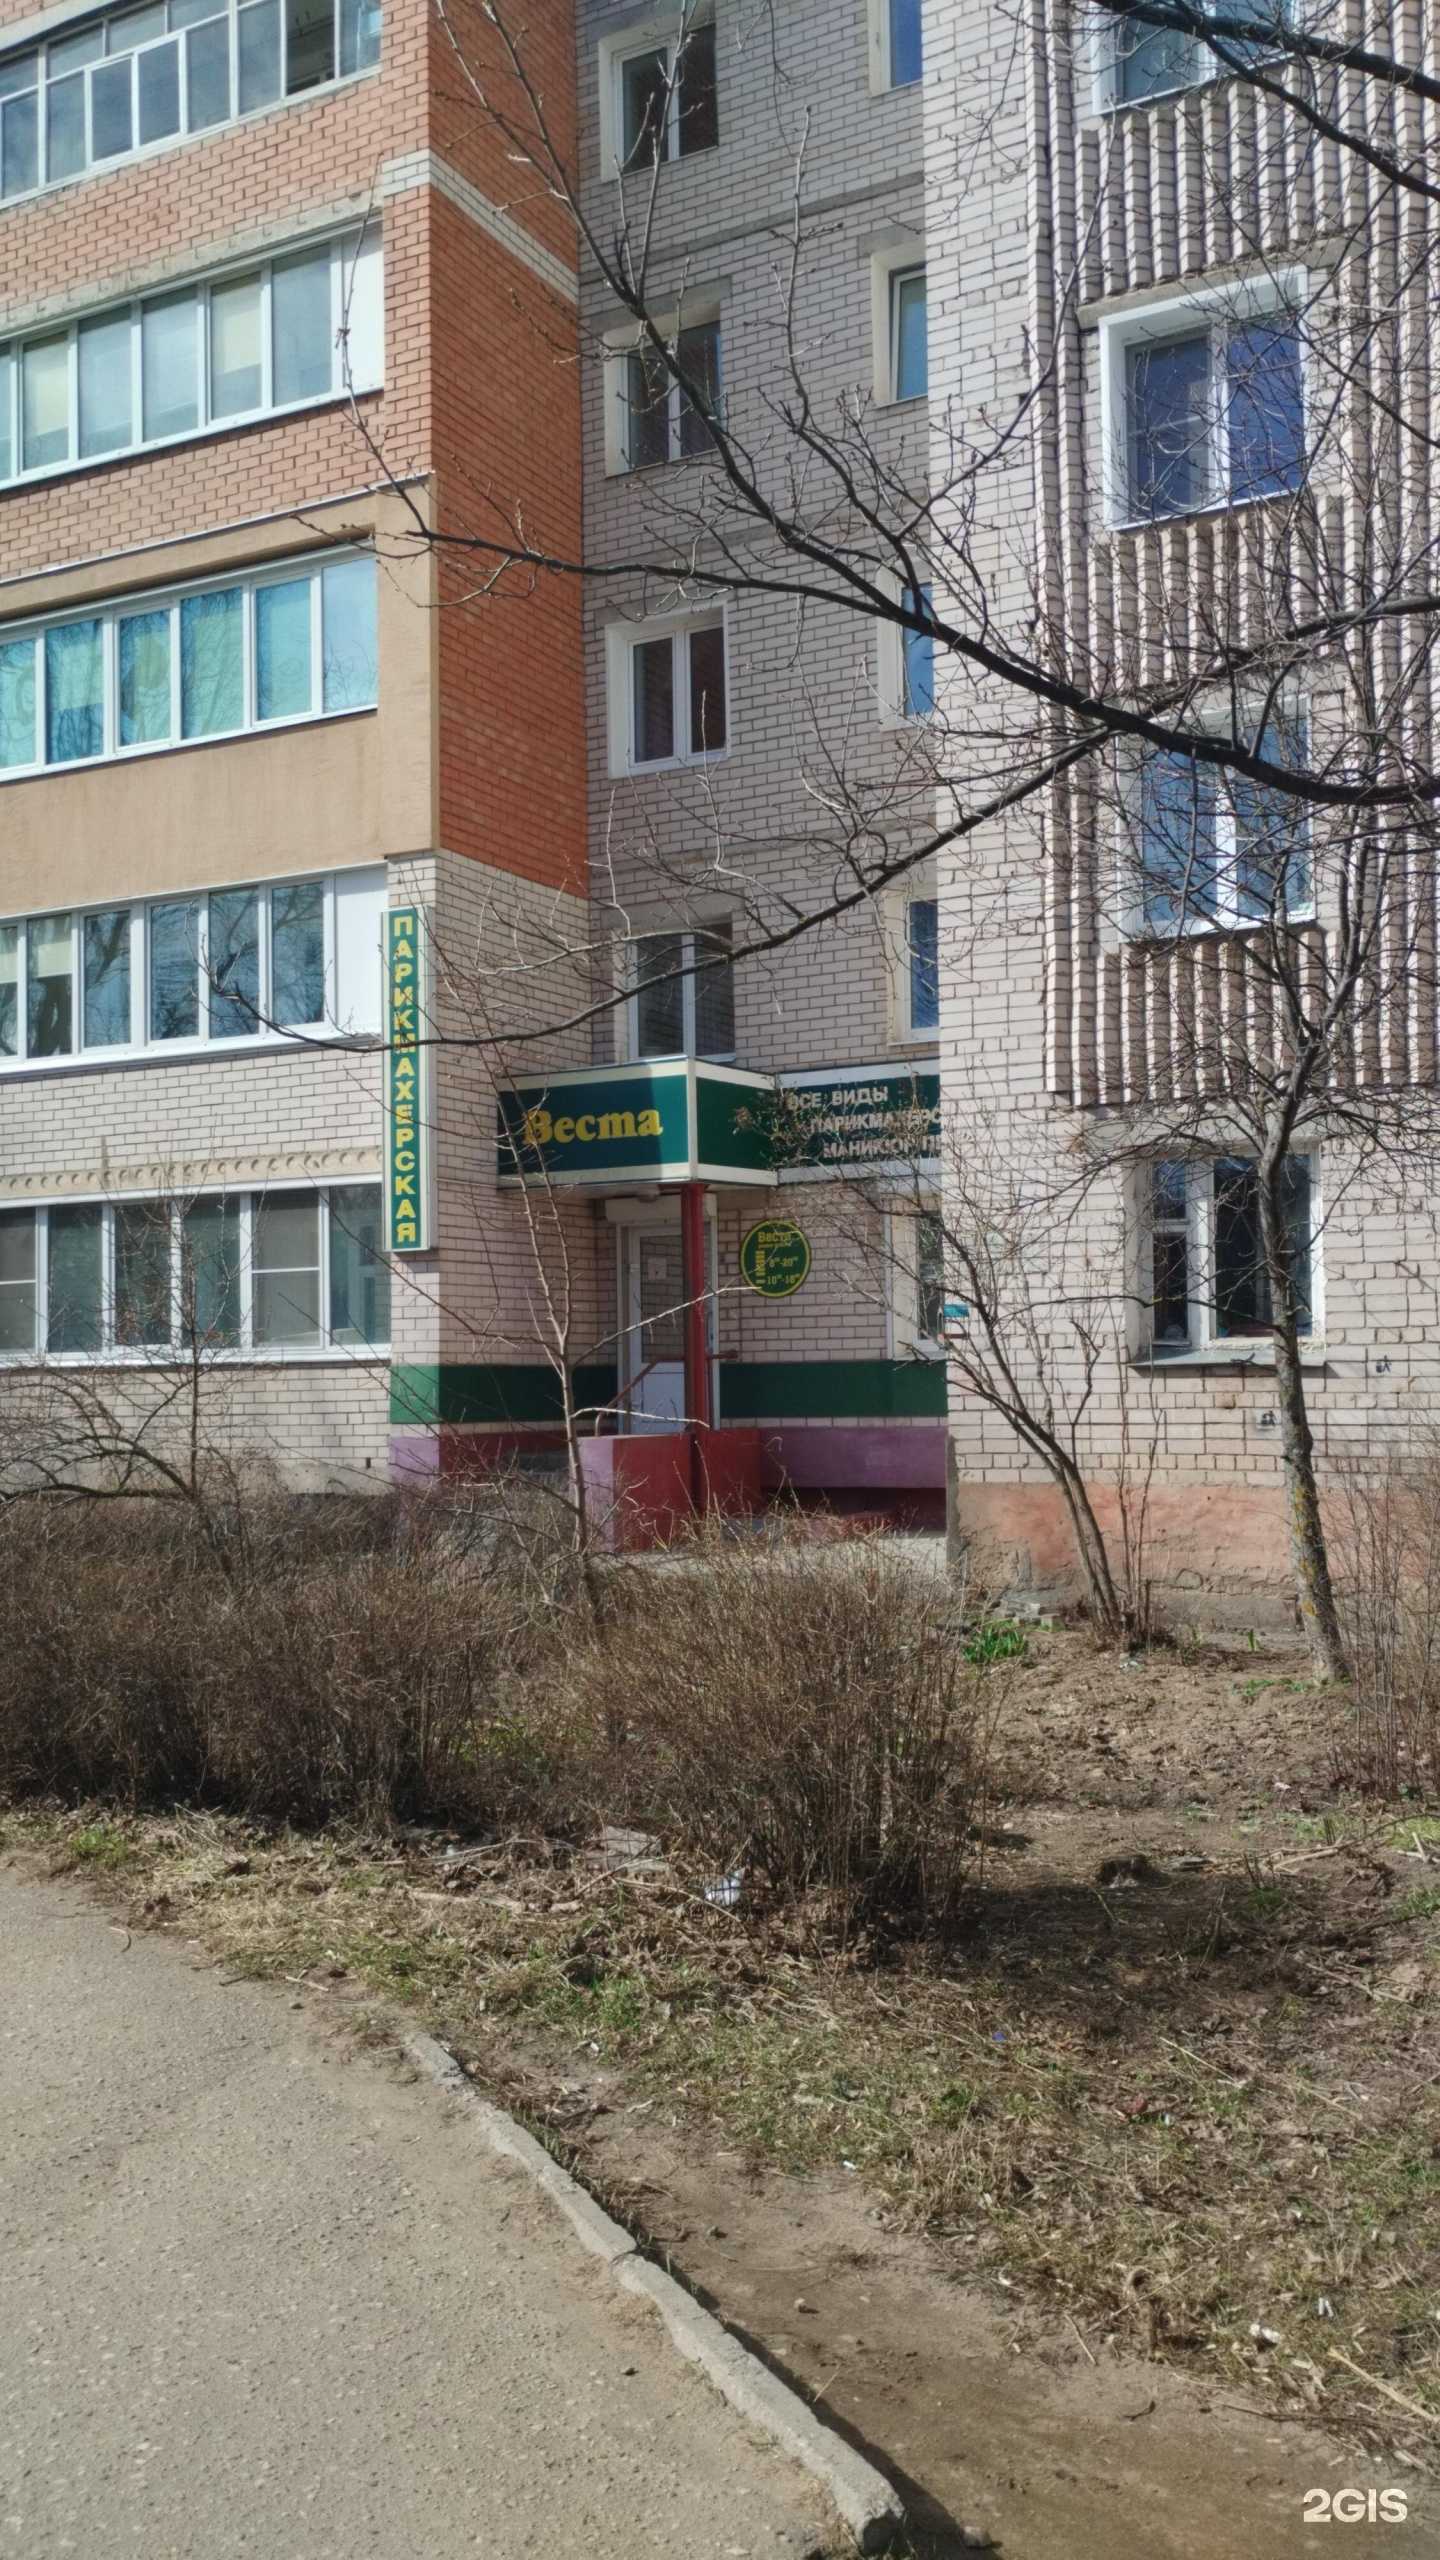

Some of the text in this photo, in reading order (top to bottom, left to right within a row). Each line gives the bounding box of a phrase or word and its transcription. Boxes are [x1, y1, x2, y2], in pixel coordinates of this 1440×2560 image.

[393, 916, 416, 1244] ПАРИКМАХЕРСКАЯ
[832, 1086, 889, 1106] ВИДЫ
[522, 1109, 664, 1145] Веста
